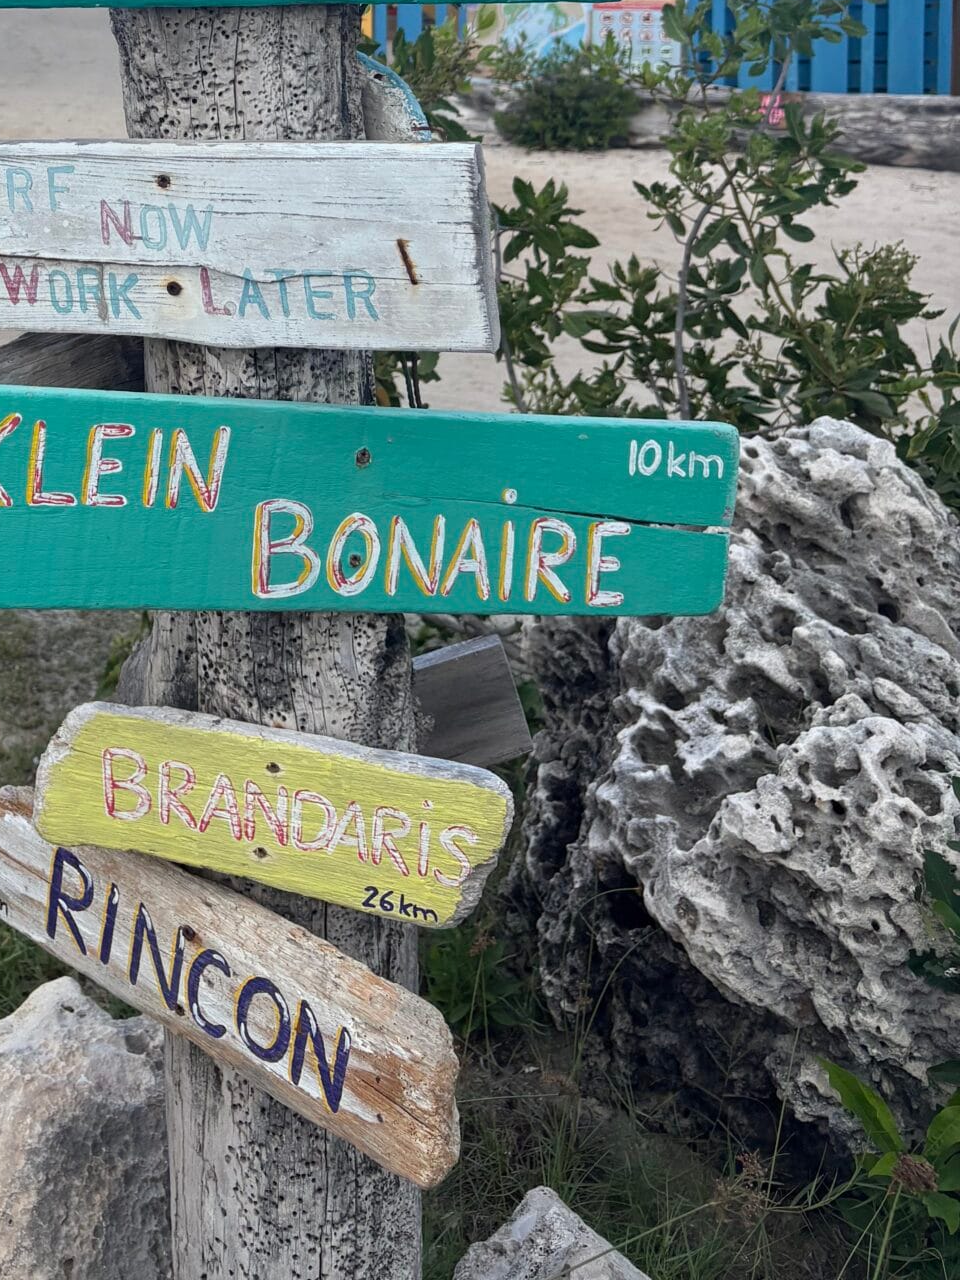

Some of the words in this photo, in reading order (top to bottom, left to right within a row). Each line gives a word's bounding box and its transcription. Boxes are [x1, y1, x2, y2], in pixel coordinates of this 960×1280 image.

[100, 199, 215, 251] NOW
[200, 266, 379, 321] LATER
[46, 847, 352, 1114] RINCON
